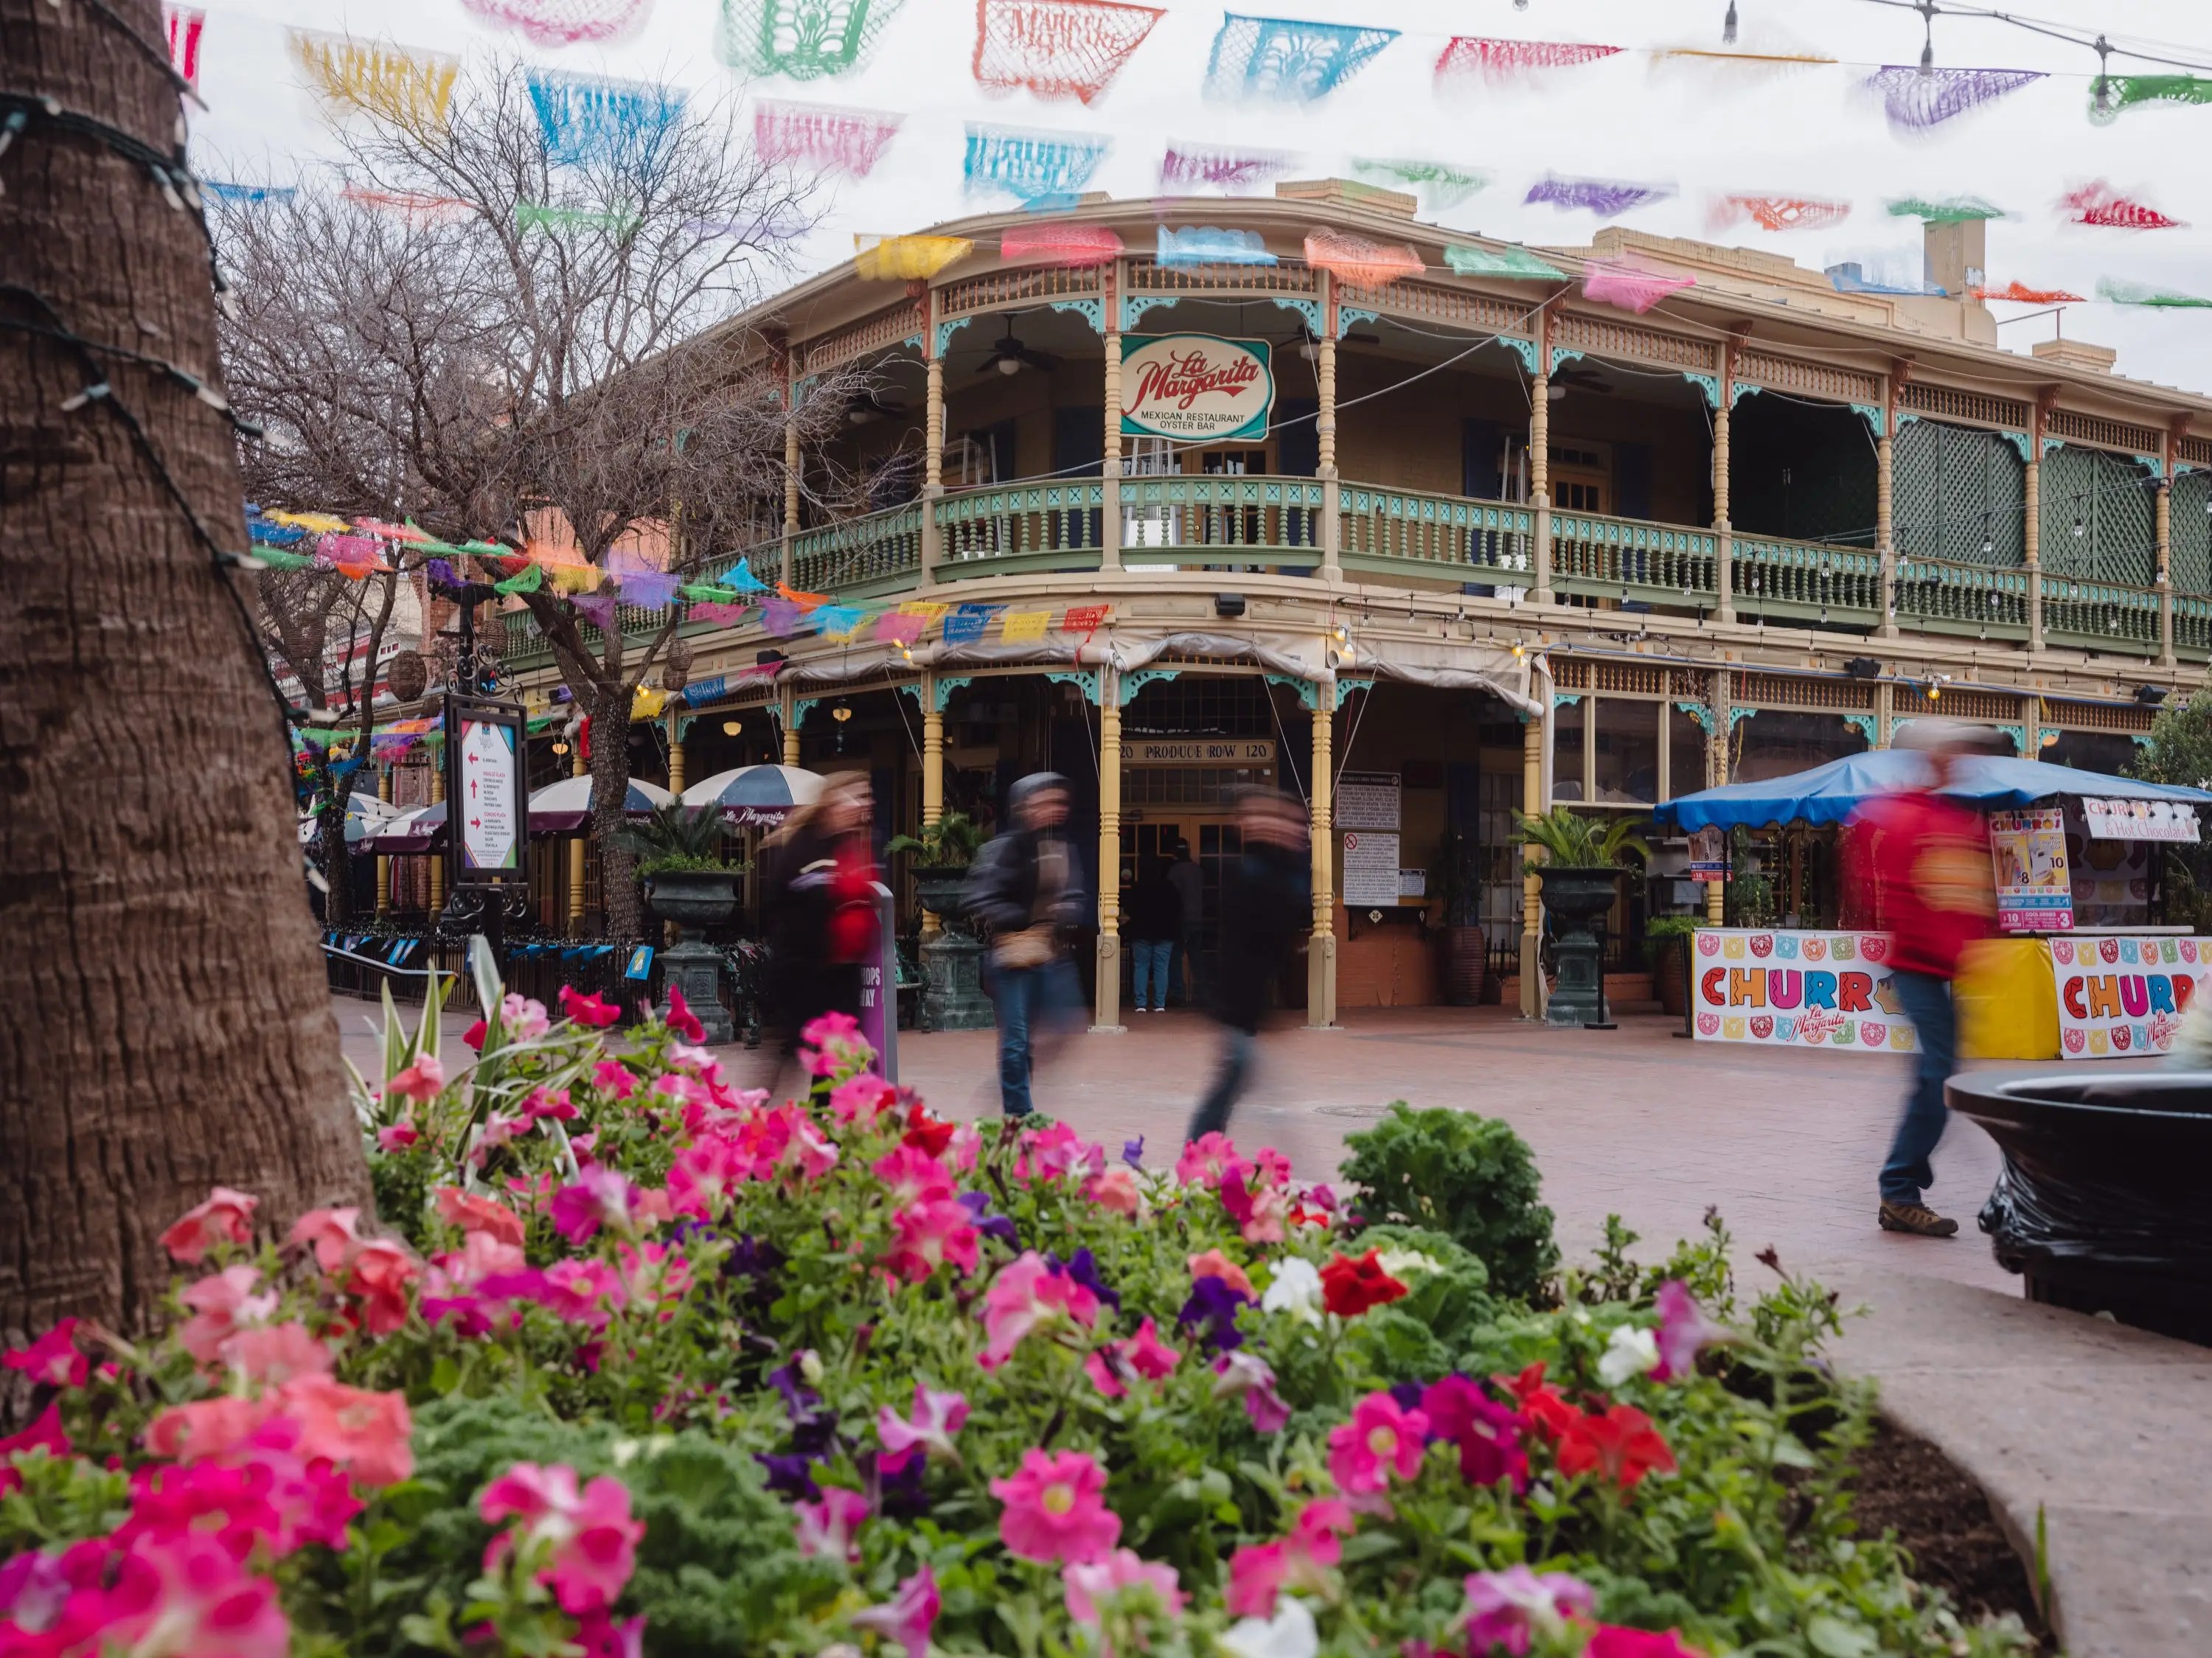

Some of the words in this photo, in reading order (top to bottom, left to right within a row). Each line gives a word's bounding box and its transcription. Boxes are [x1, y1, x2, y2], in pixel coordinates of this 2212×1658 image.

[1121, 355, 1259, 416] Margarita
[1141, 411, 1182, 420] MEXICAN
[1186, 412, 1245, 423] RESTAURANT
[1160, 421, 1194, 430] OYSTER
[1197, 421, 1215, 431] BAR
[1121, 746, 1133, 758] 20
[1144, 745, 1202, 758] PRODUCE
[1207, 745, 1236, 757] ROW
[1246, 745, 1266, 757] 120
[737, 807, 785, 826] Margarita
[2106, 822, 2114, 835] &
[2116, 822, 2135, 837] Hot
[2138, 821, 2187, 838] Chocolate
[860, 966, 880, 986] HOPS
[2063, 974, 2198, 1020] CHURR
[1809, 1003, 1823, 1020] La
[1786, 1013, 1846, 1042] Margarita
